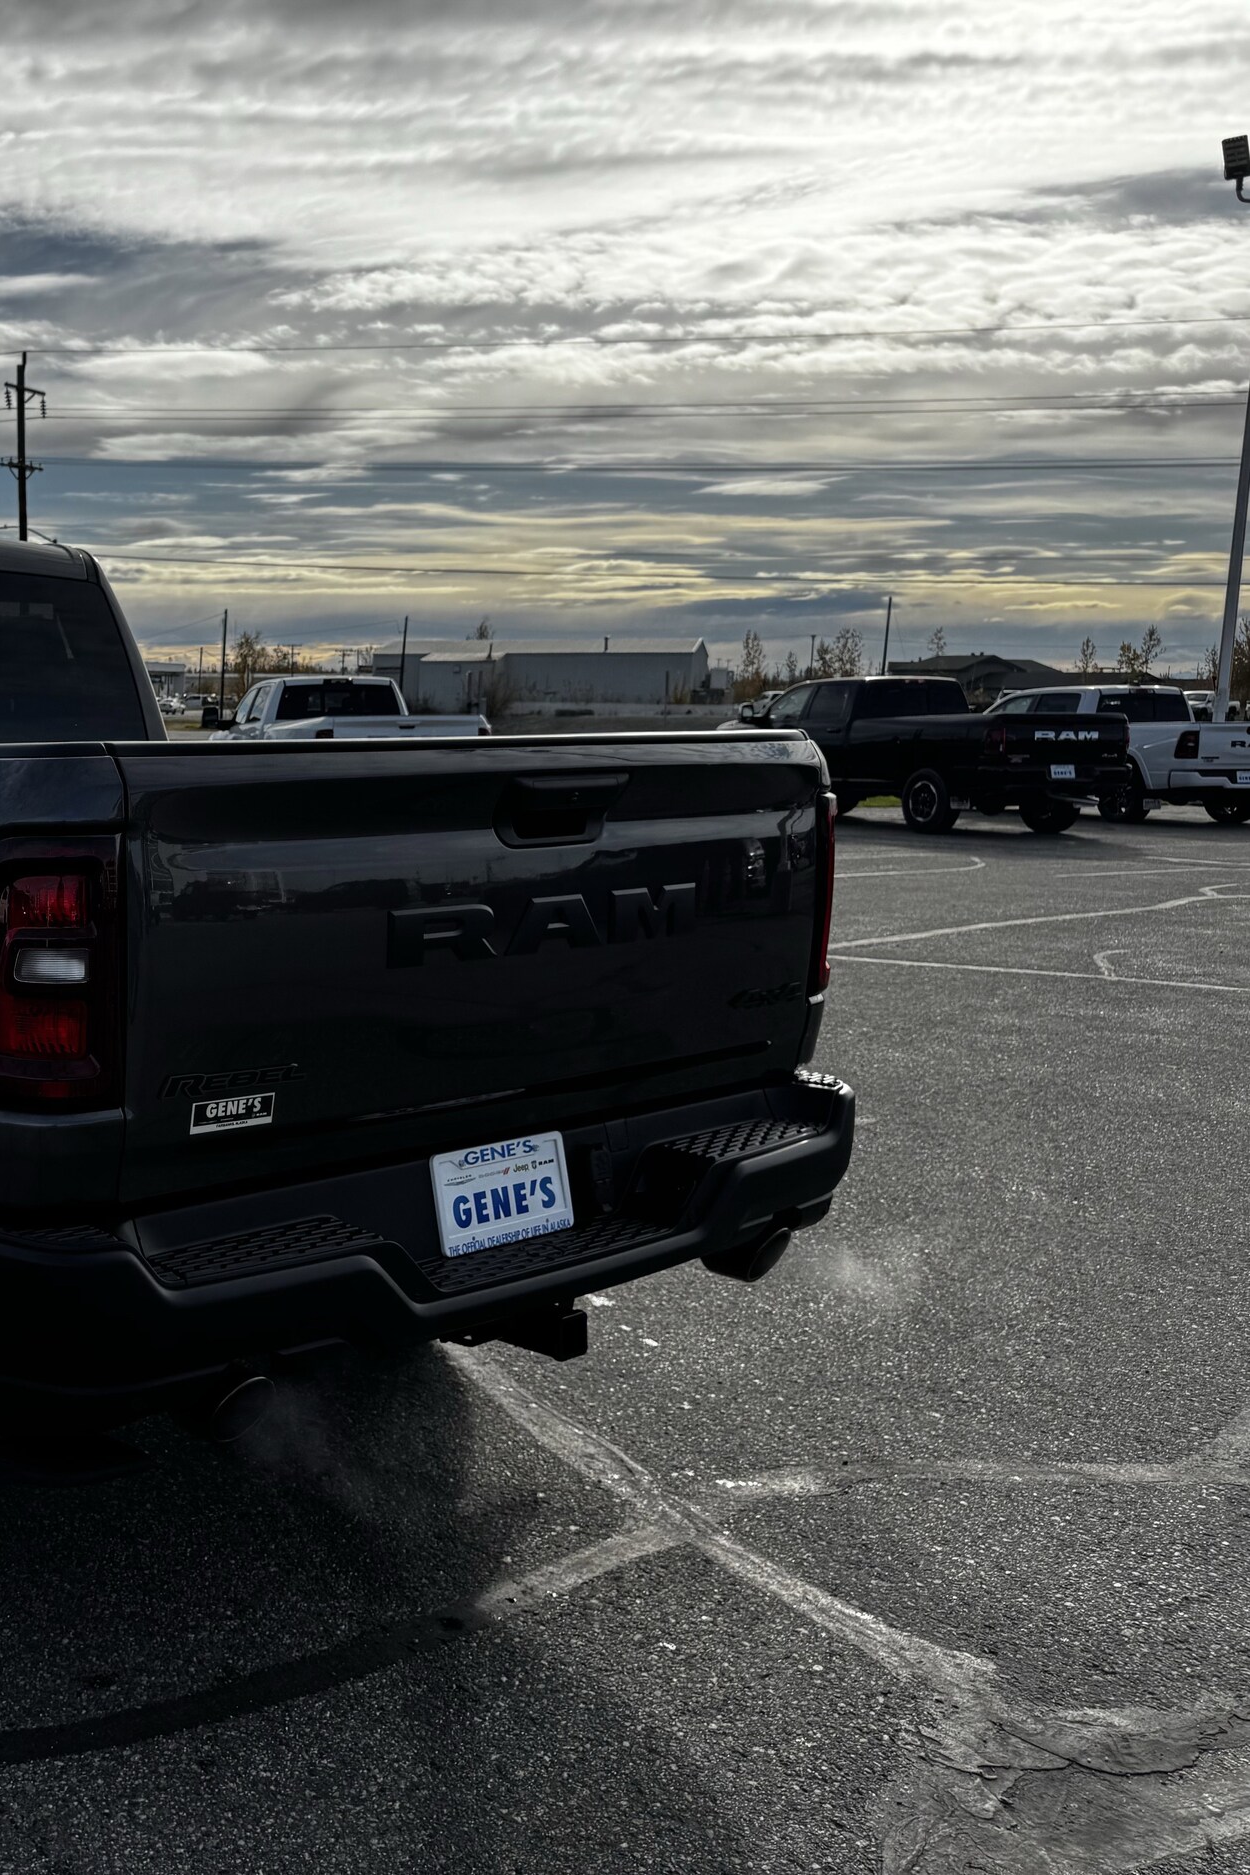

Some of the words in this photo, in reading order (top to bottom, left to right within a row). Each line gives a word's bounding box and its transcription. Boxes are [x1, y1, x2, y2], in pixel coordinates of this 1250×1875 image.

[1034, 730, 1100, 741] RAM
[387, 882, 697, 969] RAM
[157, 1062, 308, 1101] REBEL
[205, 1097, 263, 1119] GENE'S
[464, 1140, 534, 1165] GENE'S
[513, 1164, 529, 1173] Jeep
[453, 1176, 556, 1229] GENE'S
[448, 1245, 461, 1257] THE
[461, 1239, 486, 1253] OFFICIAL
[487, 1230, 521, 1247] DEALERSHIP
[521, 1228, 530, 1239] OF
[530, 1225, 541, 1236] LIFE
[541, 1223, 549, 1233] IN
[549, 1219, 571, 1231] ALASKA
